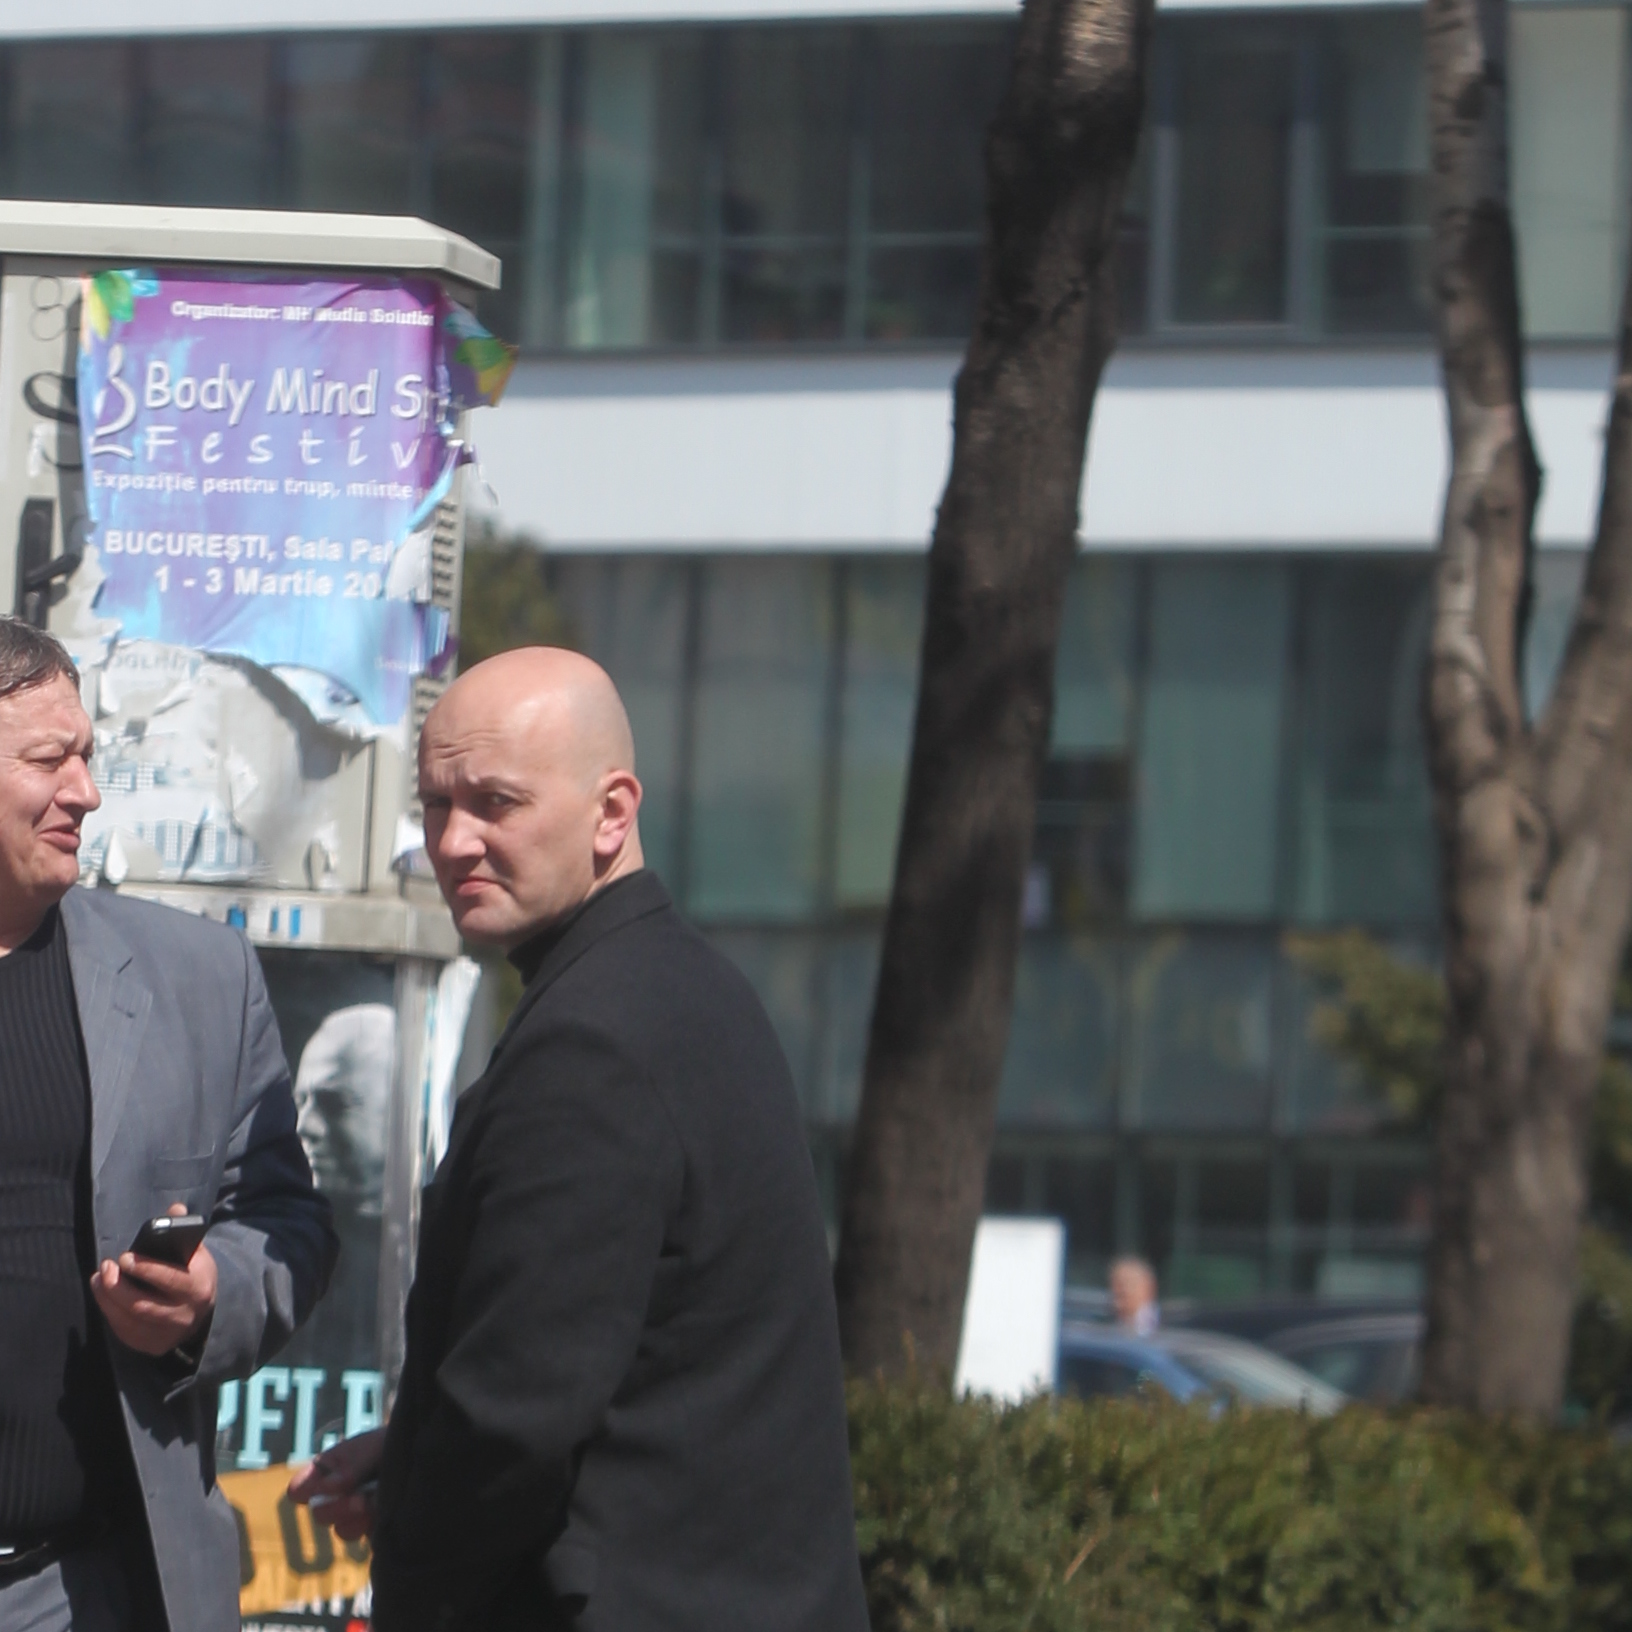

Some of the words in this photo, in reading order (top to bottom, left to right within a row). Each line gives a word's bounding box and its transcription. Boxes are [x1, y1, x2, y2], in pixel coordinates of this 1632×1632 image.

[144, 360, 256, 427] Body
[266, 367, 379, 417] Mind
[202, 473, 279, 495] pentru
[283, 477, 342, 500] trup,
[346, 478, 414, 500] minte
[283, 534, 344, 562] Sala
[153, 565, 171, 593] 1
[205, 567, 224, 595] 3
[233, 567, 334, 597] Martie
